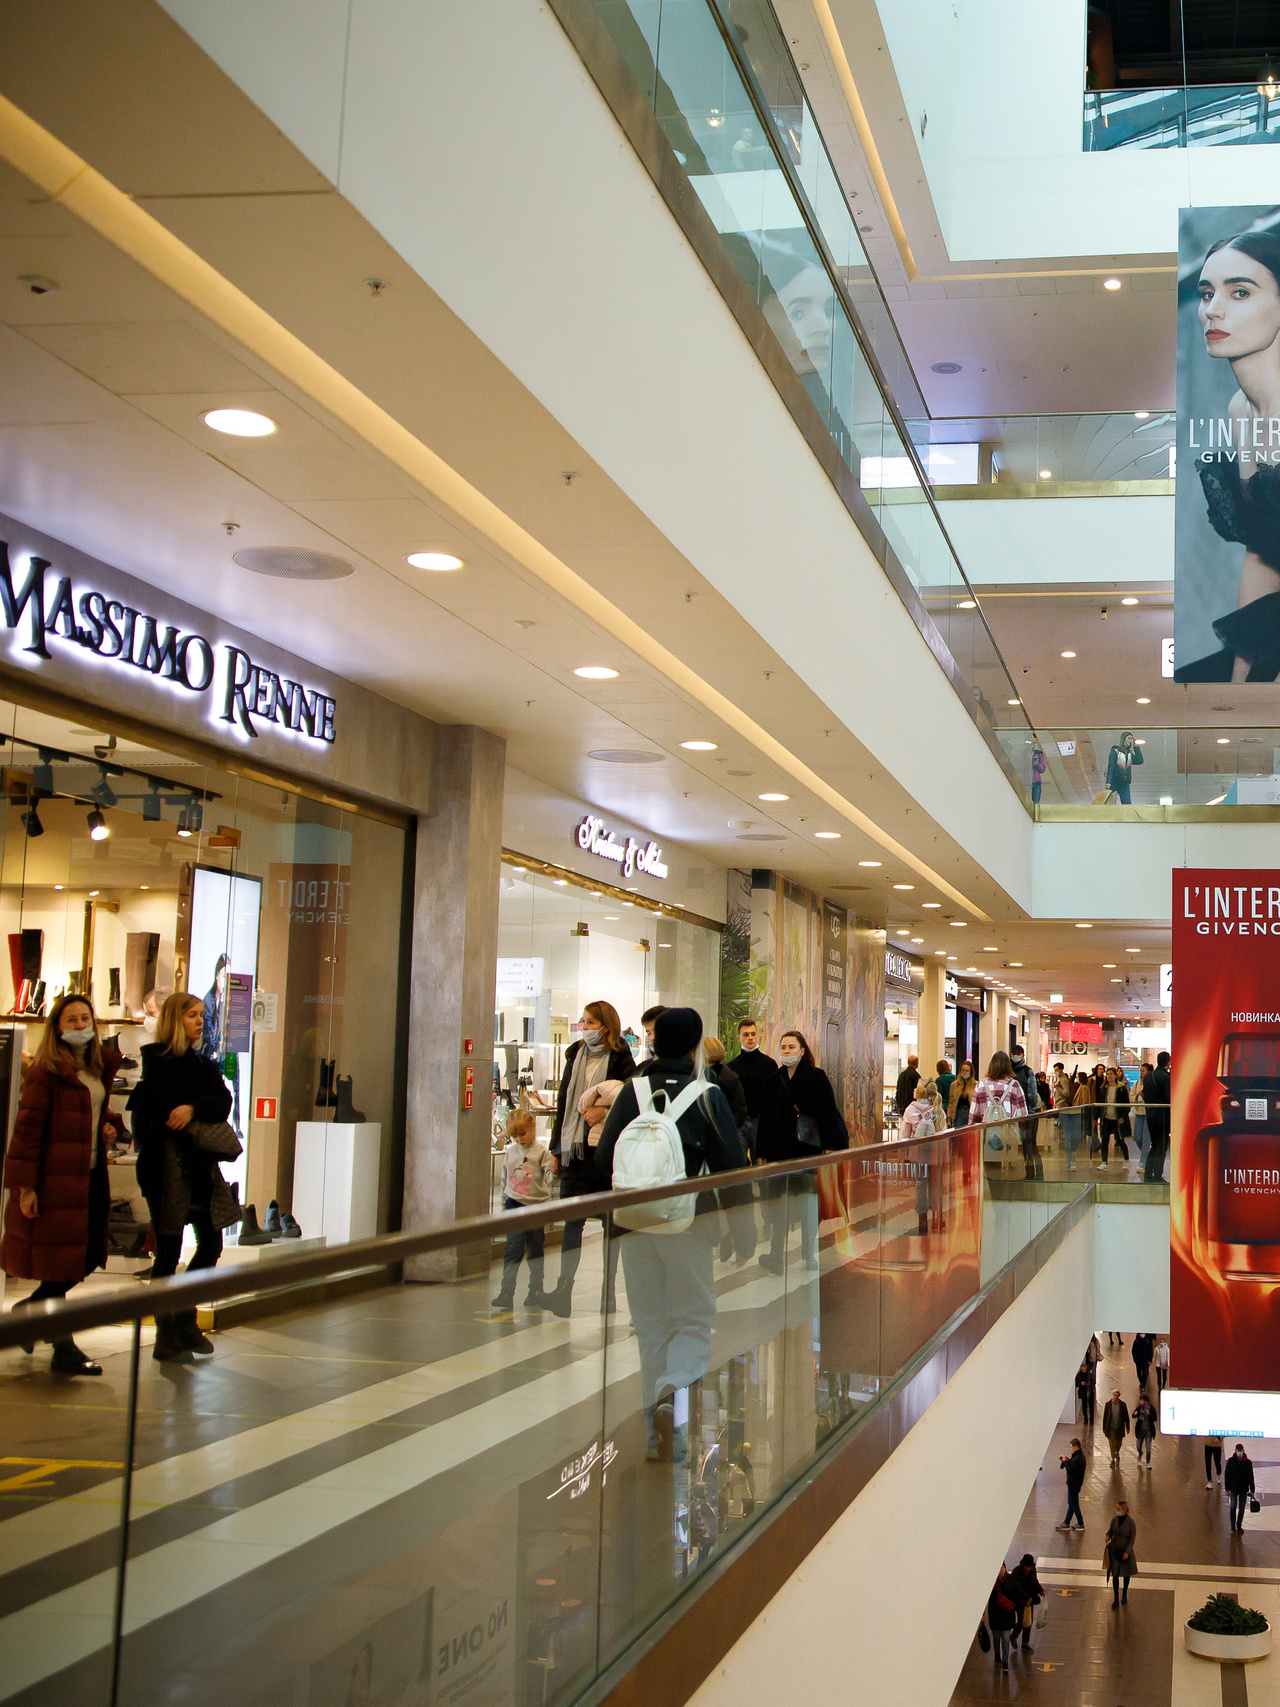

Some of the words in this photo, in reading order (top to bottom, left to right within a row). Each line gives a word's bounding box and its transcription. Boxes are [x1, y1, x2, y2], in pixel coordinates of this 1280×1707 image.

[0, 539, 215, 692] MASSIMO
[219, 645, 337, 744] RENNE
[1049, 1041, 1088, 1055] UGO
